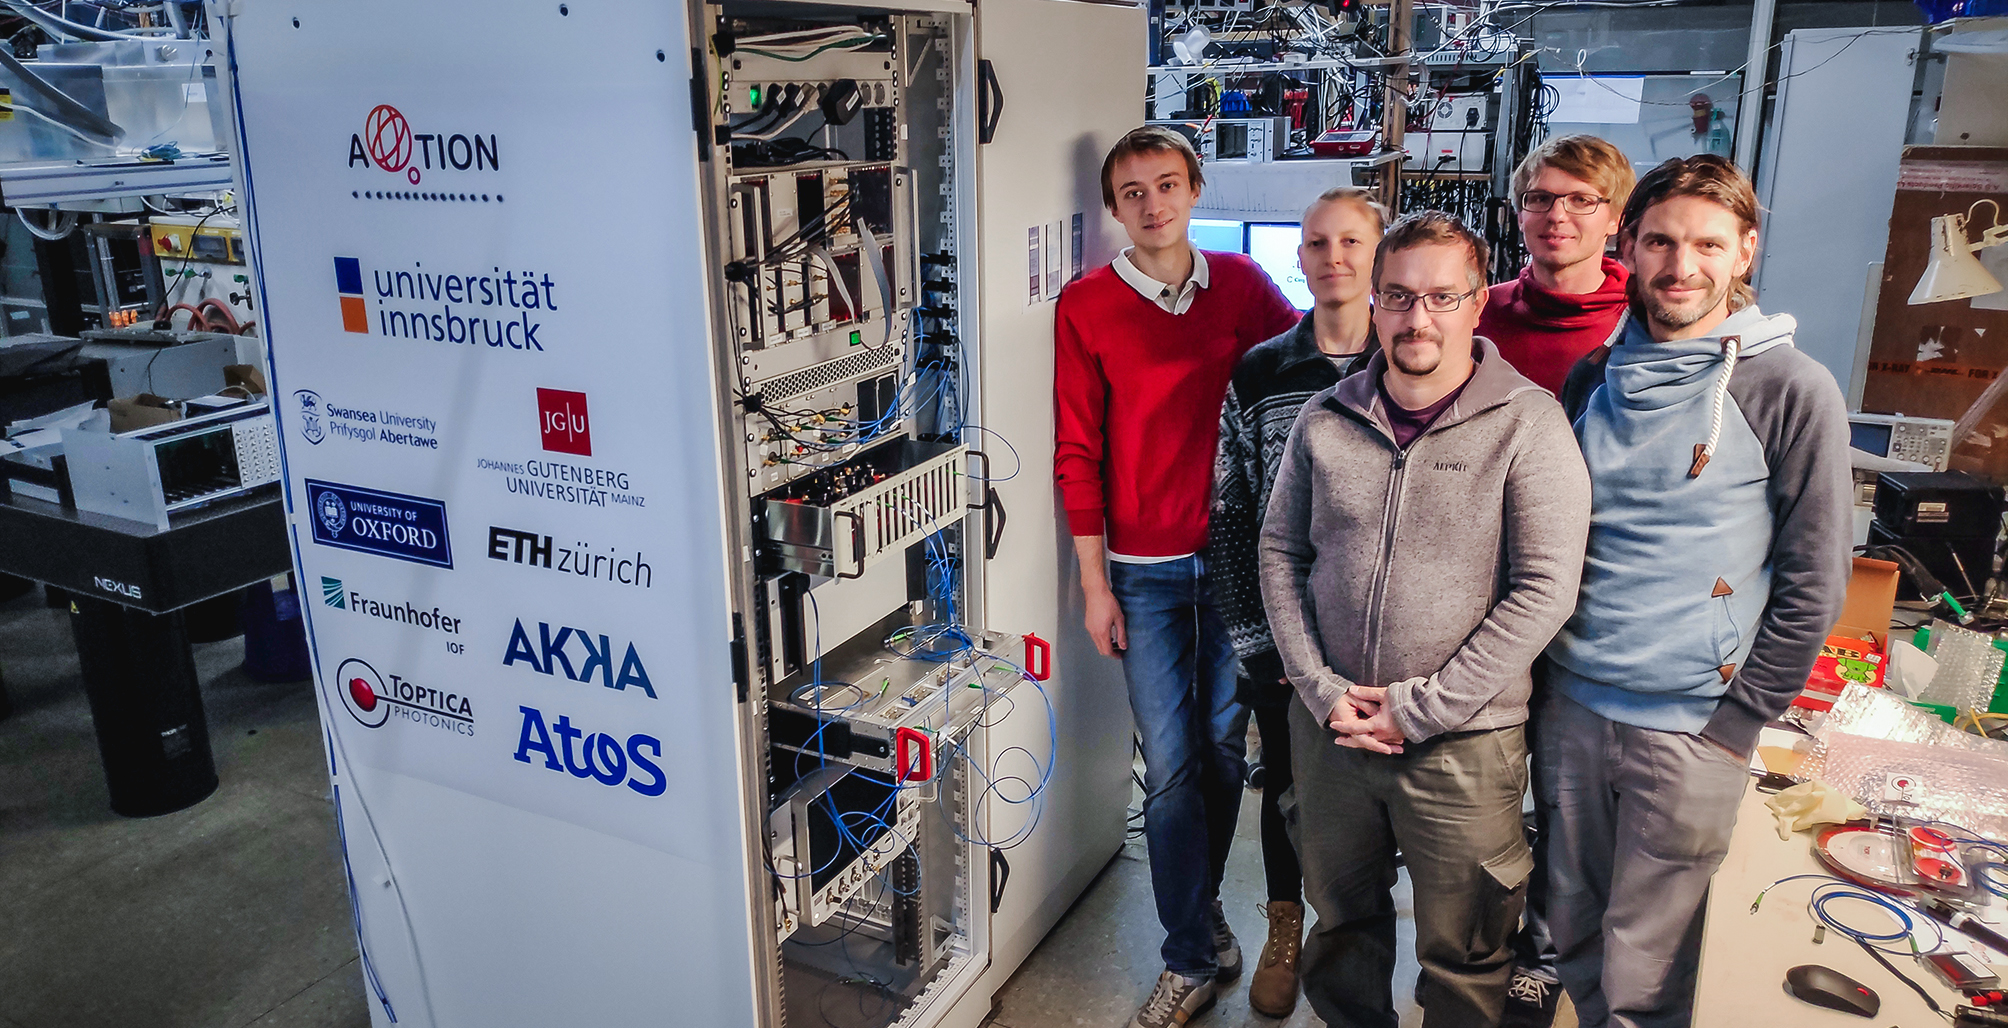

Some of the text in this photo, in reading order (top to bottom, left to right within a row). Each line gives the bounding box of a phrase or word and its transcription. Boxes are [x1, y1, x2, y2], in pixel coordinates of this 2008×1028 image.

[374, 262, 558, 311] universität
[378, 299, 544, 352] innsbruck
[326, 403, 436, 434] Swansea University
[329, 421, 438, 449] Prifysgol Abertawe
[477, 458, 629, 490] JOHANNES GUTENBERG
[506, 476, 645, 507] UNIVERSITÄT MAINZ
[350, 501, 402, 519] UNIVERSITY
[404, 510, 417, 521] OF
[352, 517, 437, 549] OXFORD
[488, 525, 652, 588] ETH zürich
[93, 576, 142, 599] NEXUS
[350, 591, 461, 634] Fraunhofer
[446, 641, 465, 655] IOF
[502, 616, 658, 700] AKKA
[389, 674, 473, 717] TOPTICA
[394, 705, 474, 737] PHOTONICS
[513, 705, 667, 797] Atos
